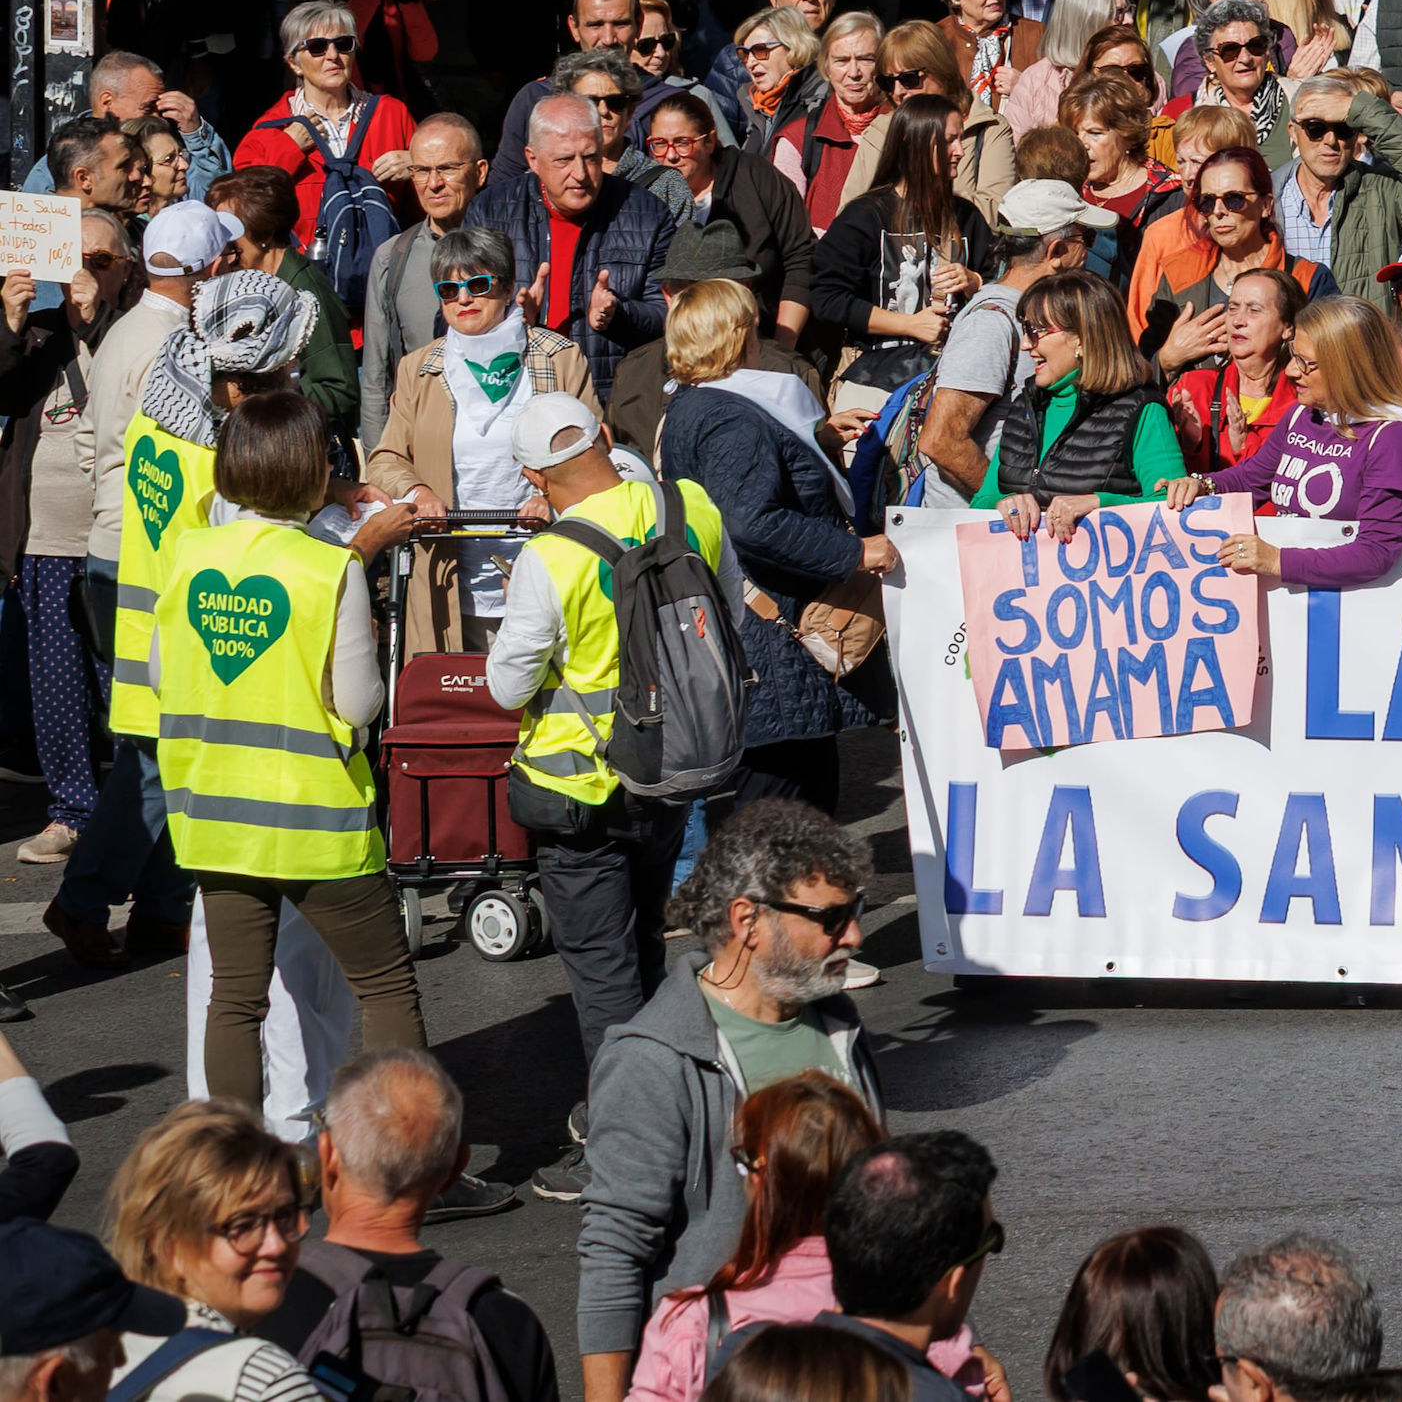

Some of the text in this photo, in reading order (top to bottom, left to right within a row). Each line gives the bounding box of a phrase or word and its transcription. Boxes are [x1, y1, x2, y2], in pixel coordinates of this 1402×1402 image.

[33, 199, 73, 218] Salud
[48, 242, 74, 270] 100%
[1287, 431, 1353, 458] GRANADA
[137, 456, 174, 491] SANIDAD
[988, 495, 1232, 587] TODAS
[197, 591, 274, 617] SANIDAD
[992, 565, 1241, 656] SOMOS
[200, 611, 270, 639] PÚBLICA
[211, 638, 256, 659] 100%
[986, 636, 1236, 749] AMAMA
[943, 780, 1107, 919] LA
